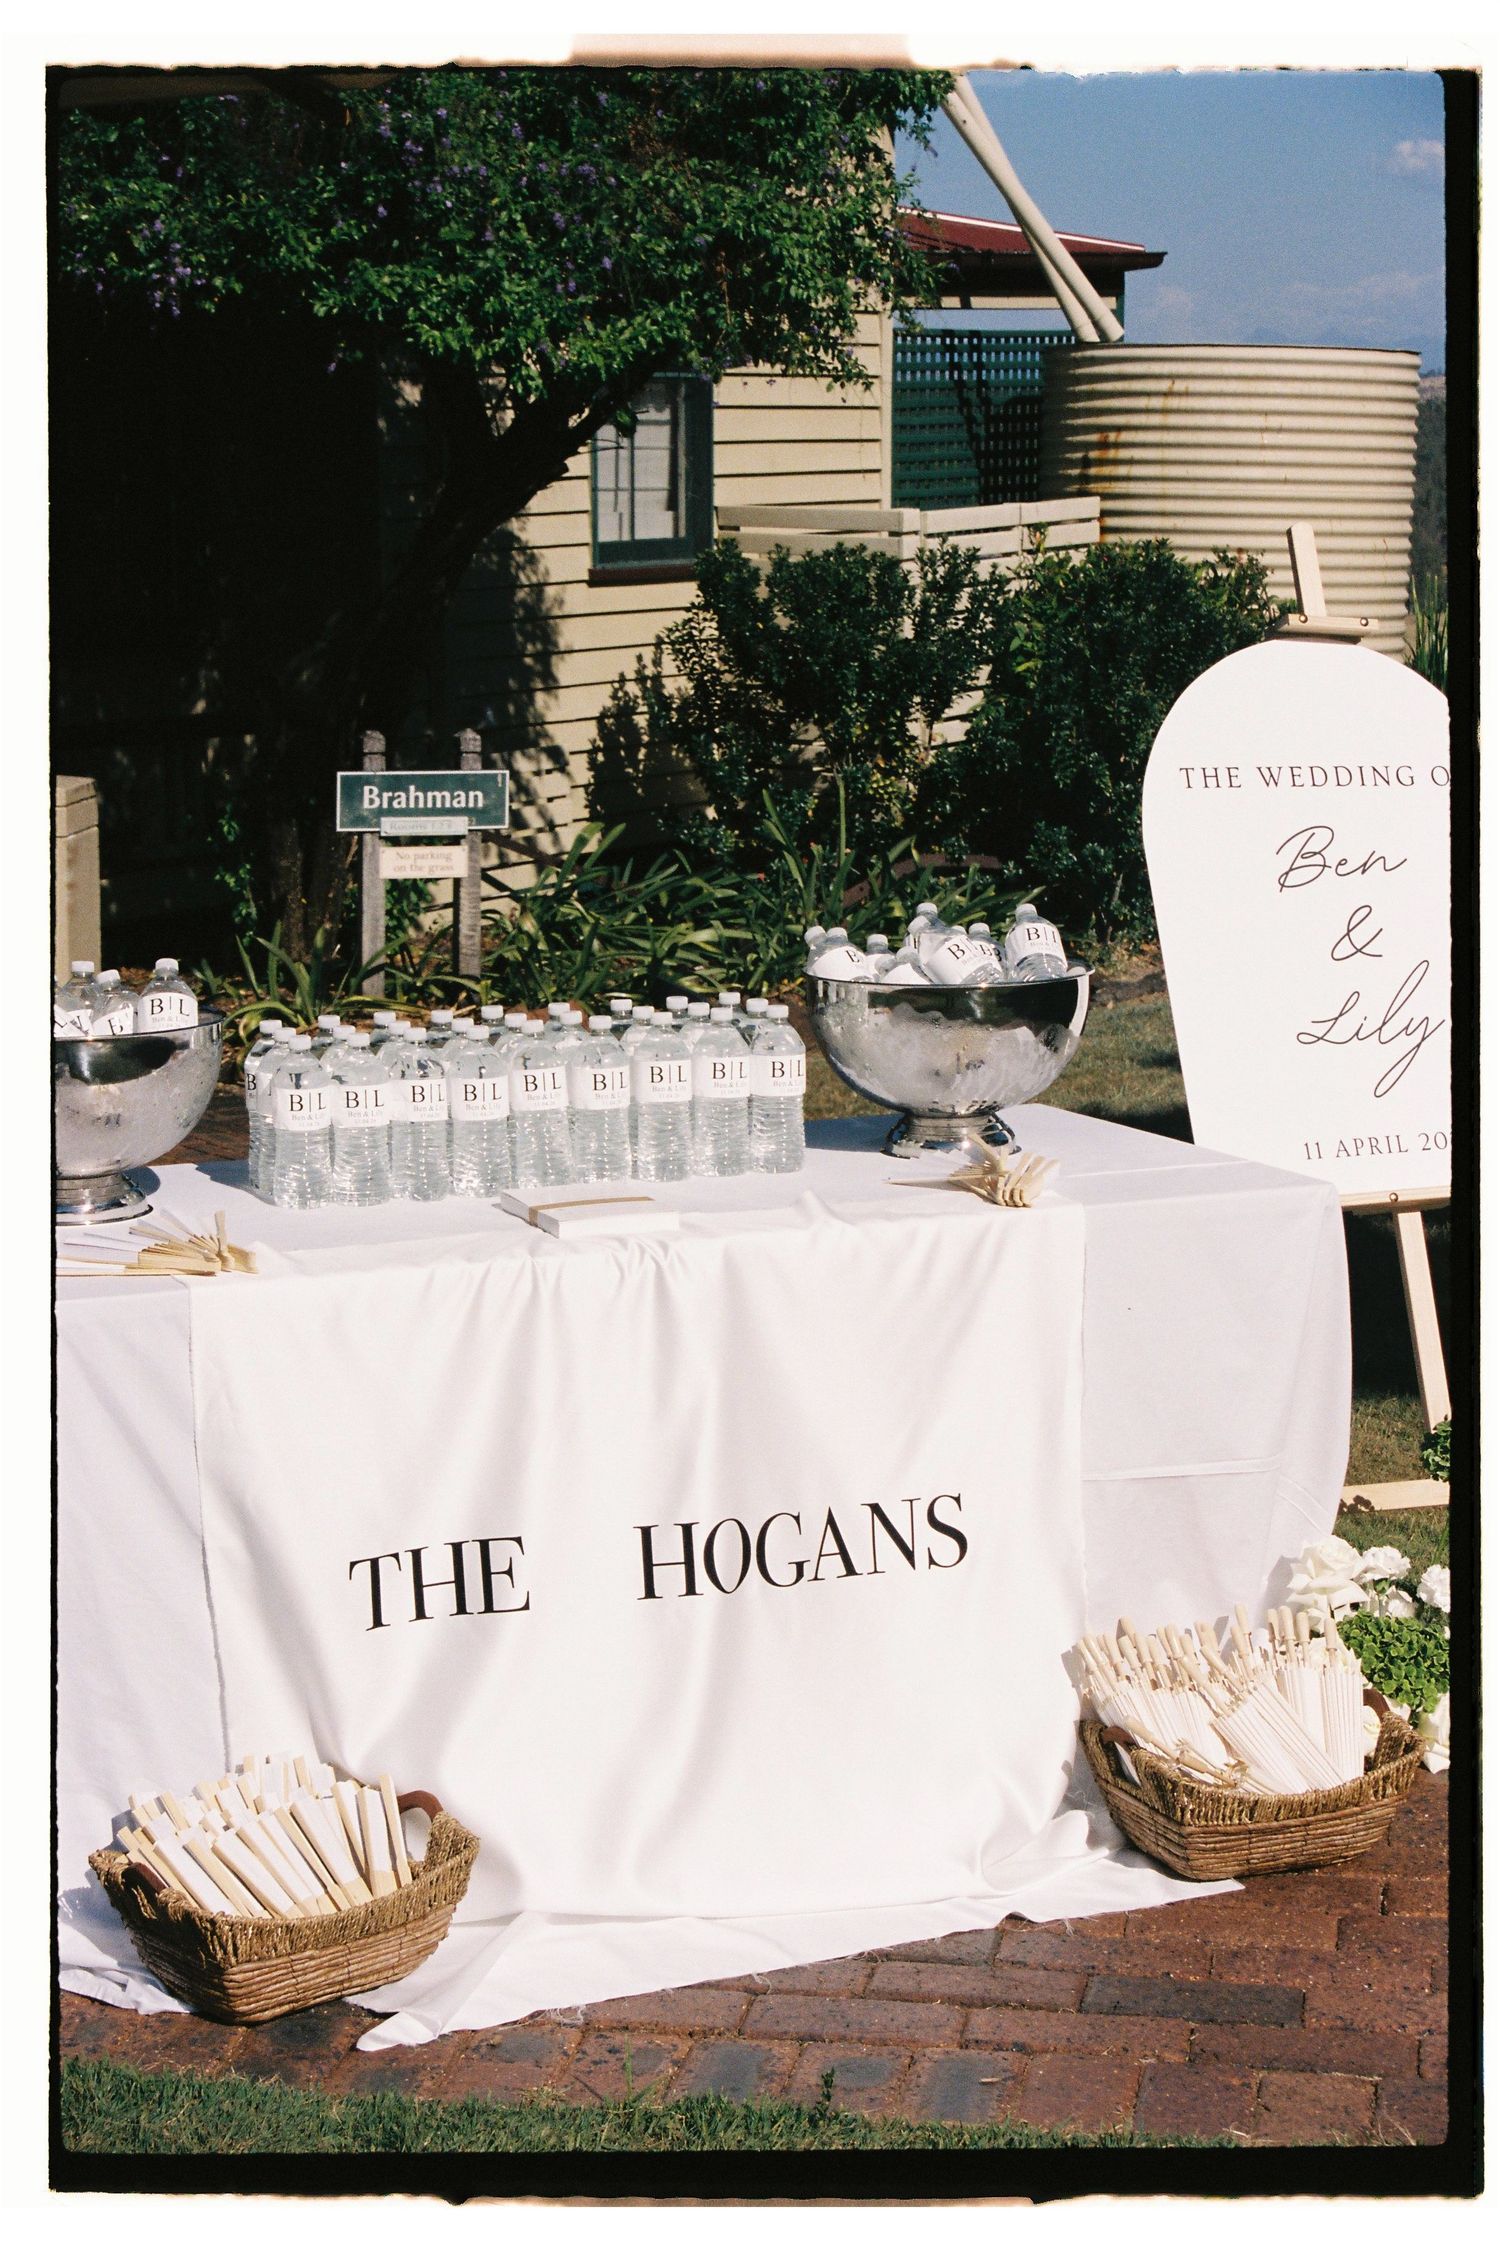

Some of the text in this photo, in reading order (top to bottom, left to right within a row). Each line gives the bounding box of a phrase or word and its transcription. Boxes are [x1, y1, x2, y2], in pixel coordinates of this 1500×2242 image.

[1179, 767, 1242, 789] THE
[1256, 765, 1416, 788] WEDDING
[363, 785, 484, 809] Brahman
[393, 865, 407, 873] on
[409, 863, 426, 872] the
[413, 851, 454, 864] parking
[1275, 825, 1408, 893] Ben
[1330, 904, 1383, 961] &
[1296, 959, 1446, 1098] Lily
[1304, 1131, 1452, 1160] 11 APRIL 20
[349, 1493, 969, 1631] THE HOGANS
